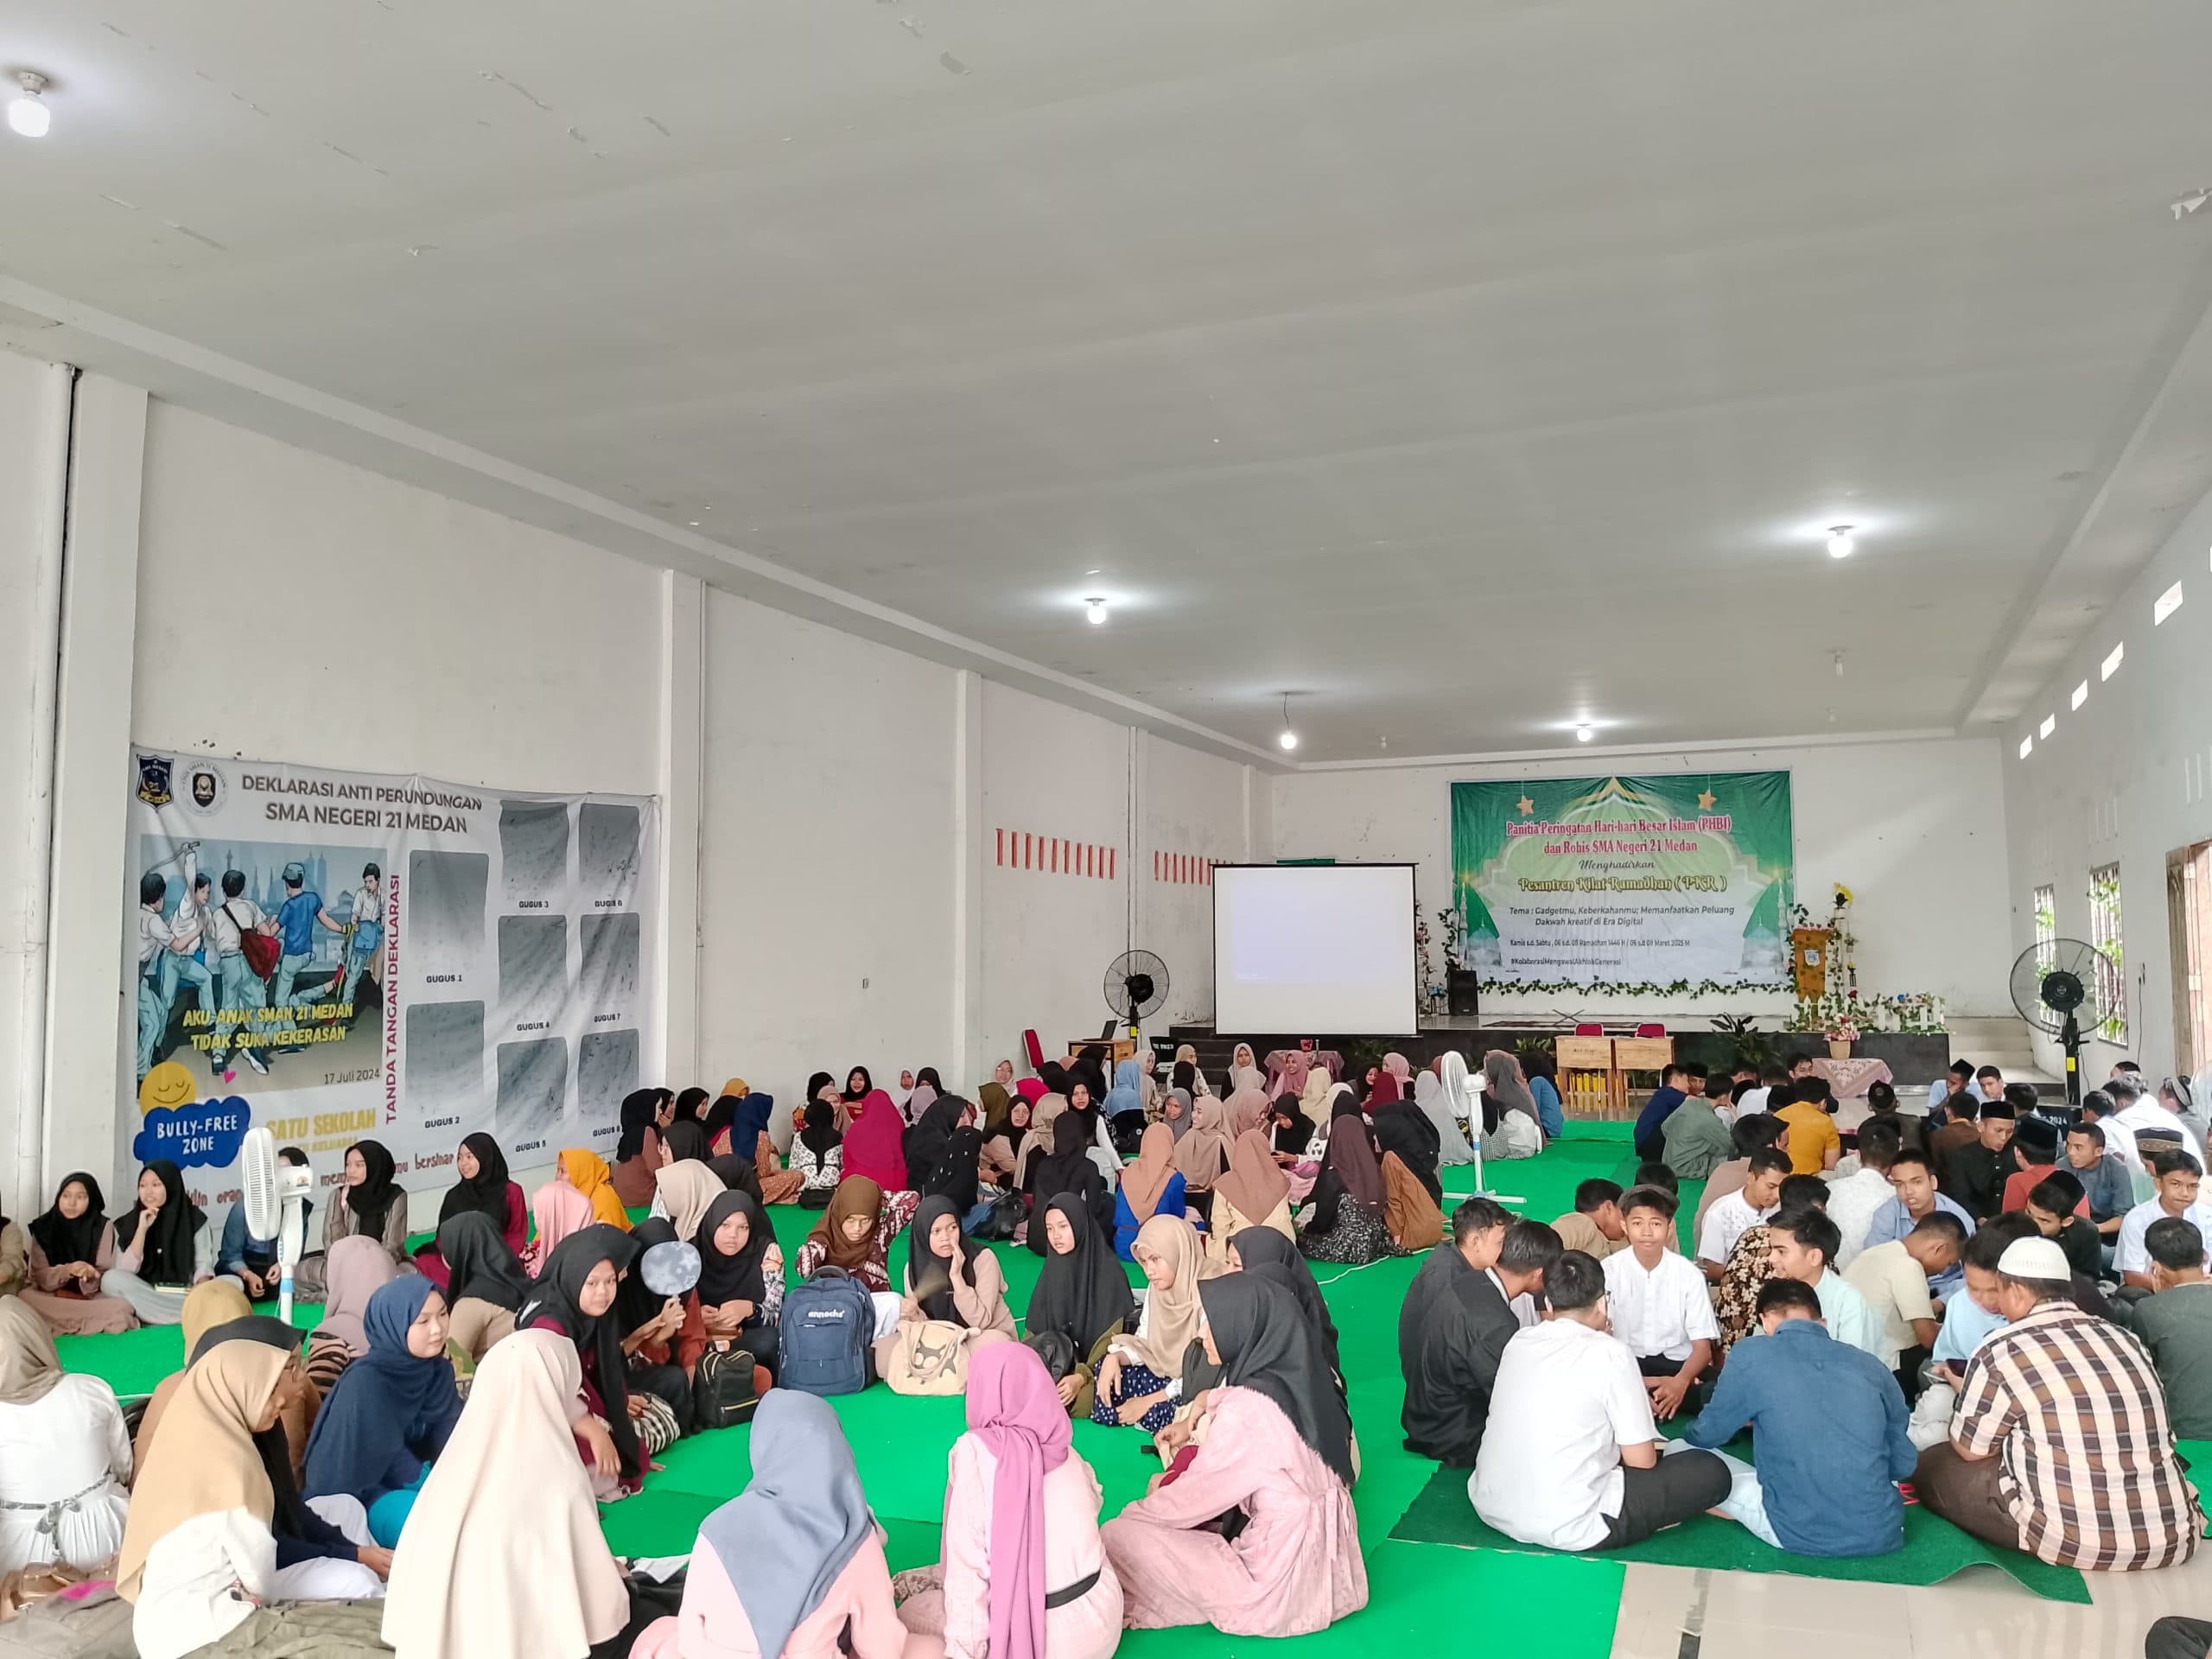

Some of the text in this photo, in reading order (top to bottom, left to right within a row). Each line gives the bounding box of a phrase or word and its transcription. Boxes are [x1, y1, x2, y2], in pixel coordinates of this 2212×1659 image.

[242, 774, 483, 810] DEKLARASI ANTI PERUNDUNGAN
[266, 802, 467, 834] SMA NEGERI 21 MEDAN
[1506, 816, 1732, 836] Panitia Peringatan Hari-hari Besar Islam (PHBI)
[1544, 838, 1698, 855] dan Rohis SMA Negeri 21 Medan
[1578, 859, 1655, 872] Menghadirkan
[1518, 877, 1574, 892] Pesantren
[1575, 876, 1608, 893] Kilat
[1607, 875, 1673, 893] Ramadhan
[518, 900, 543, 909] GUGUS
[1509, 906, 1529, 915] Tema
[1535, 906, 1576, 916] Gadgetmu,
[1640, 905, 1700, 914] Memanfaatkan
[1701, 905, 1735, 916] Peluang
[1617, 917, 1643, 927] Digital
[426, 974, 463, 983] GUGUS 1
[385, 874, 400, 1125] TANDA TANGAN DEKLARASI
[182, 1003, 354, 1027] AKU ANAK SMAN 21 MEDAN
[594, 1013, 616, 1023] GUGUS
[517, 1021, 544, 1032] GUGUS
[190, 1027, 347, 1052] TIDAK SUKA KEKERASAN
[324, 1069, 380, 1084] 17 Juli 2024
[156, 1114, 238, 1140] BULLY-FREE
[266, 1108, 377, 1141] SATU SEKOLAH
[423, 1116, 461, 1128] GUGUS 2
[593, 1126, 615, 1137] GUGUS
[182, 1136, 215, 1155] ZONE
[515, 1140, 541, 1152] GUGUS
[415, 1153, 454, 1171] bersinar
